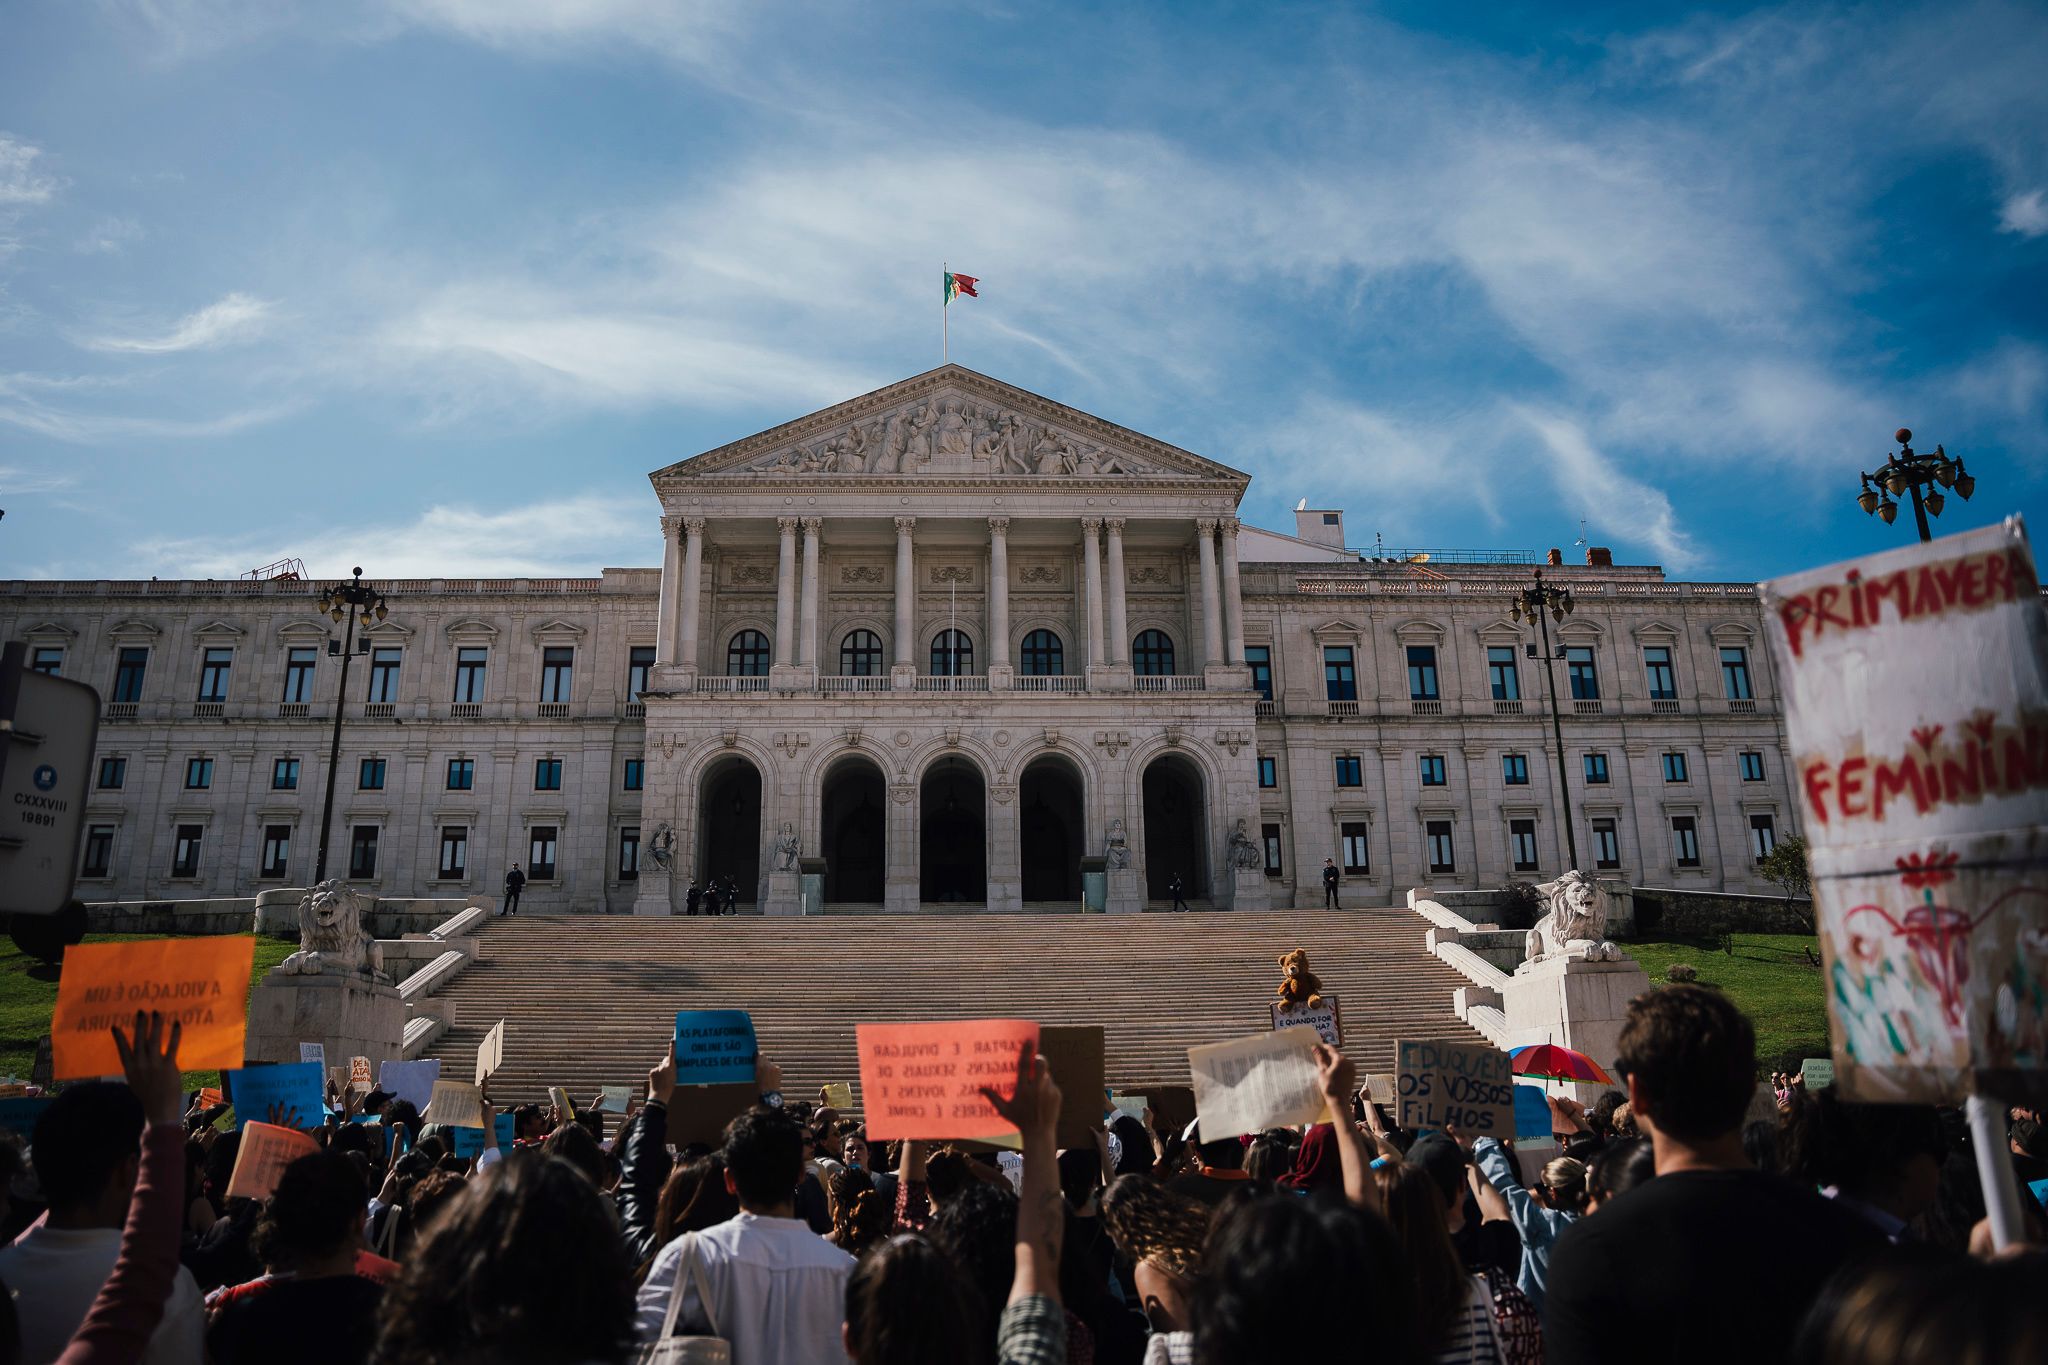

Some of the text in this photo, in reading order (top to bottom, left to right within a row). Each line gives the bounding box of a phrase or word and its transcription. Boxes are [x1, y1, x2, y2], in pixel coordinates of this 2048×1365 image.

[14, 792, 67, 812] CXXXVIII
[21, 810, 56, 827] 19891
[1286, 1017, 1316, 1025] QUANDO
[1401, 1043, 1512, 1081] EDUQUEM
[1398, 1072, 1433, 1098] OS
[1442, 1075, 1513, 1106] VOSSOS
